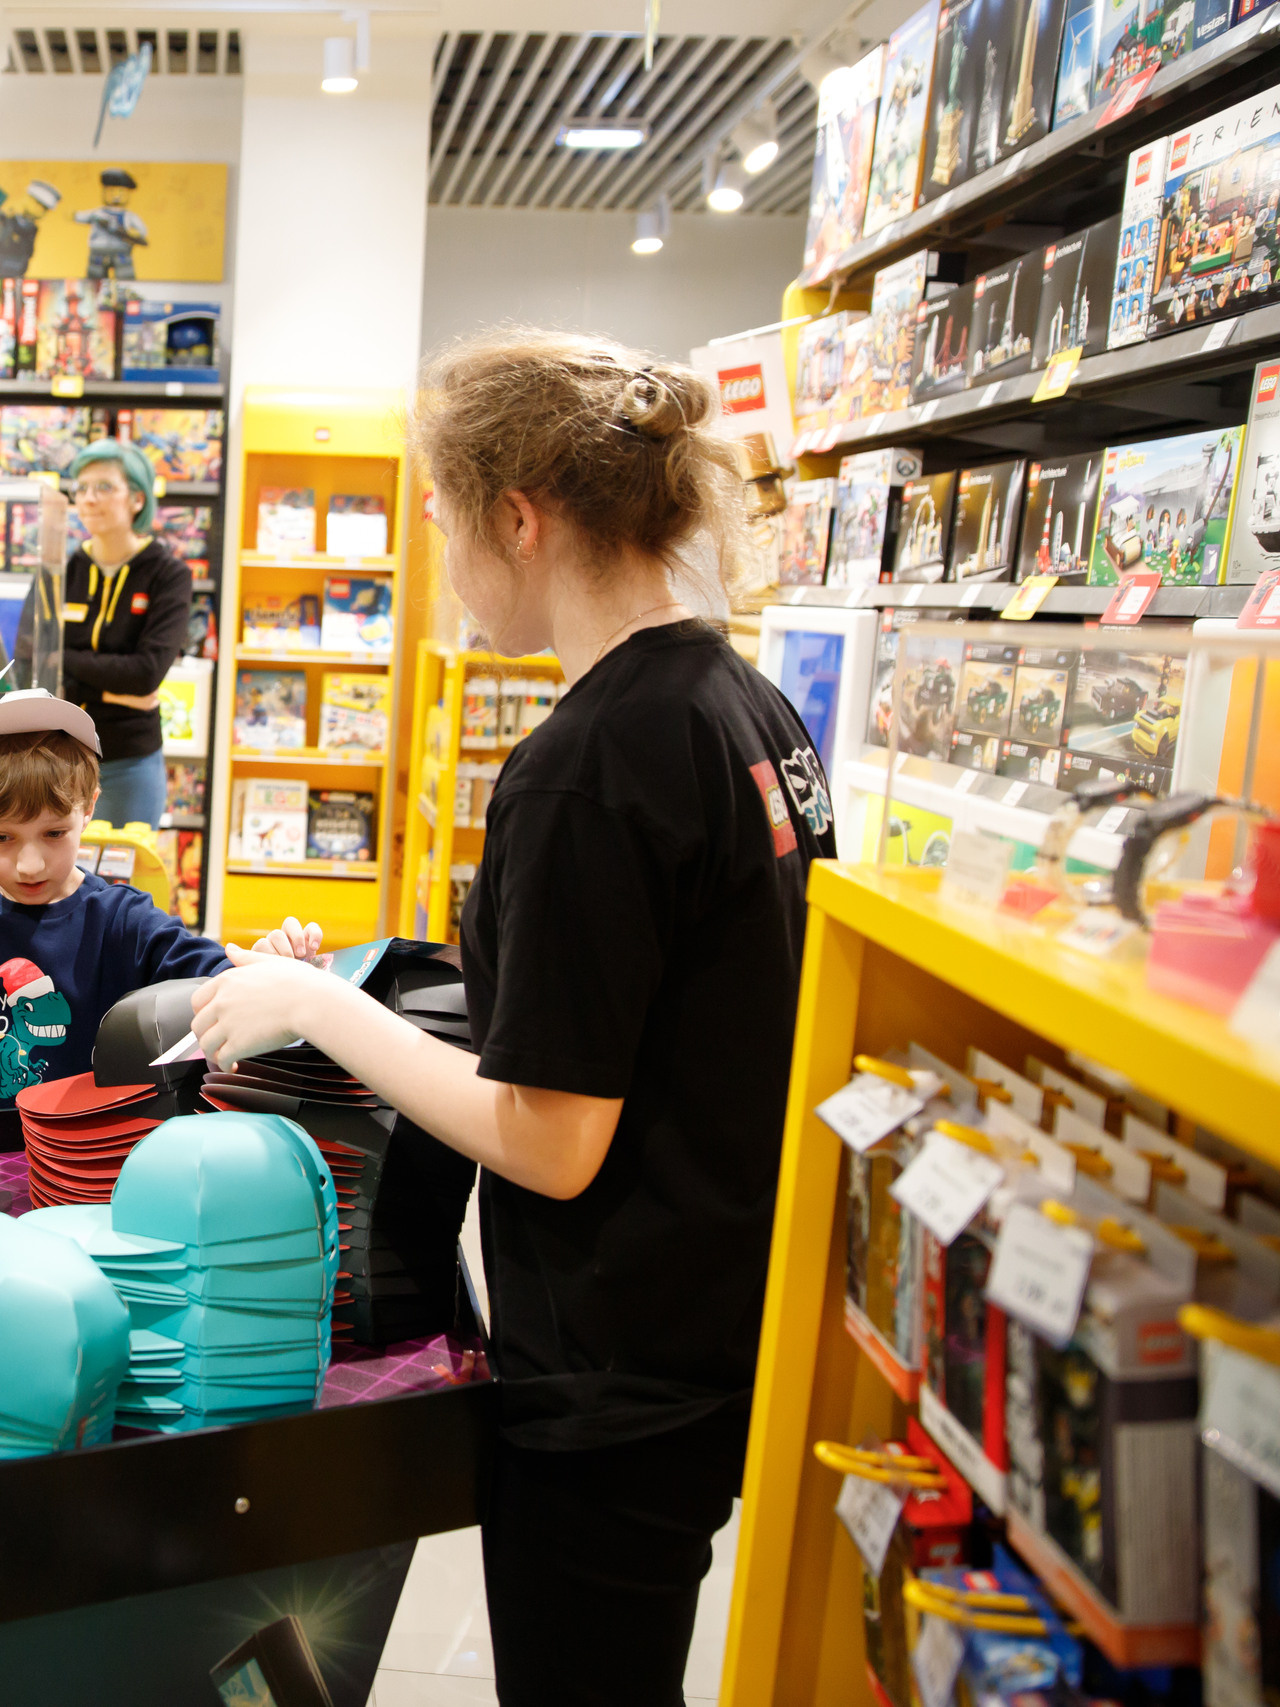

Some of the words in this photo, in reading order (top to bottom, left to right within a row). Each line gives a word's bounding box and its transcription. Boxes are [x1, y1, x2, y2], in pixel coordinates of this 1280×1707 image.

[1196, 12, 1227, 39] Vestas
[723, 376, 762, 401] LEGO
[1260, 375, 1278, 392] LEGO
